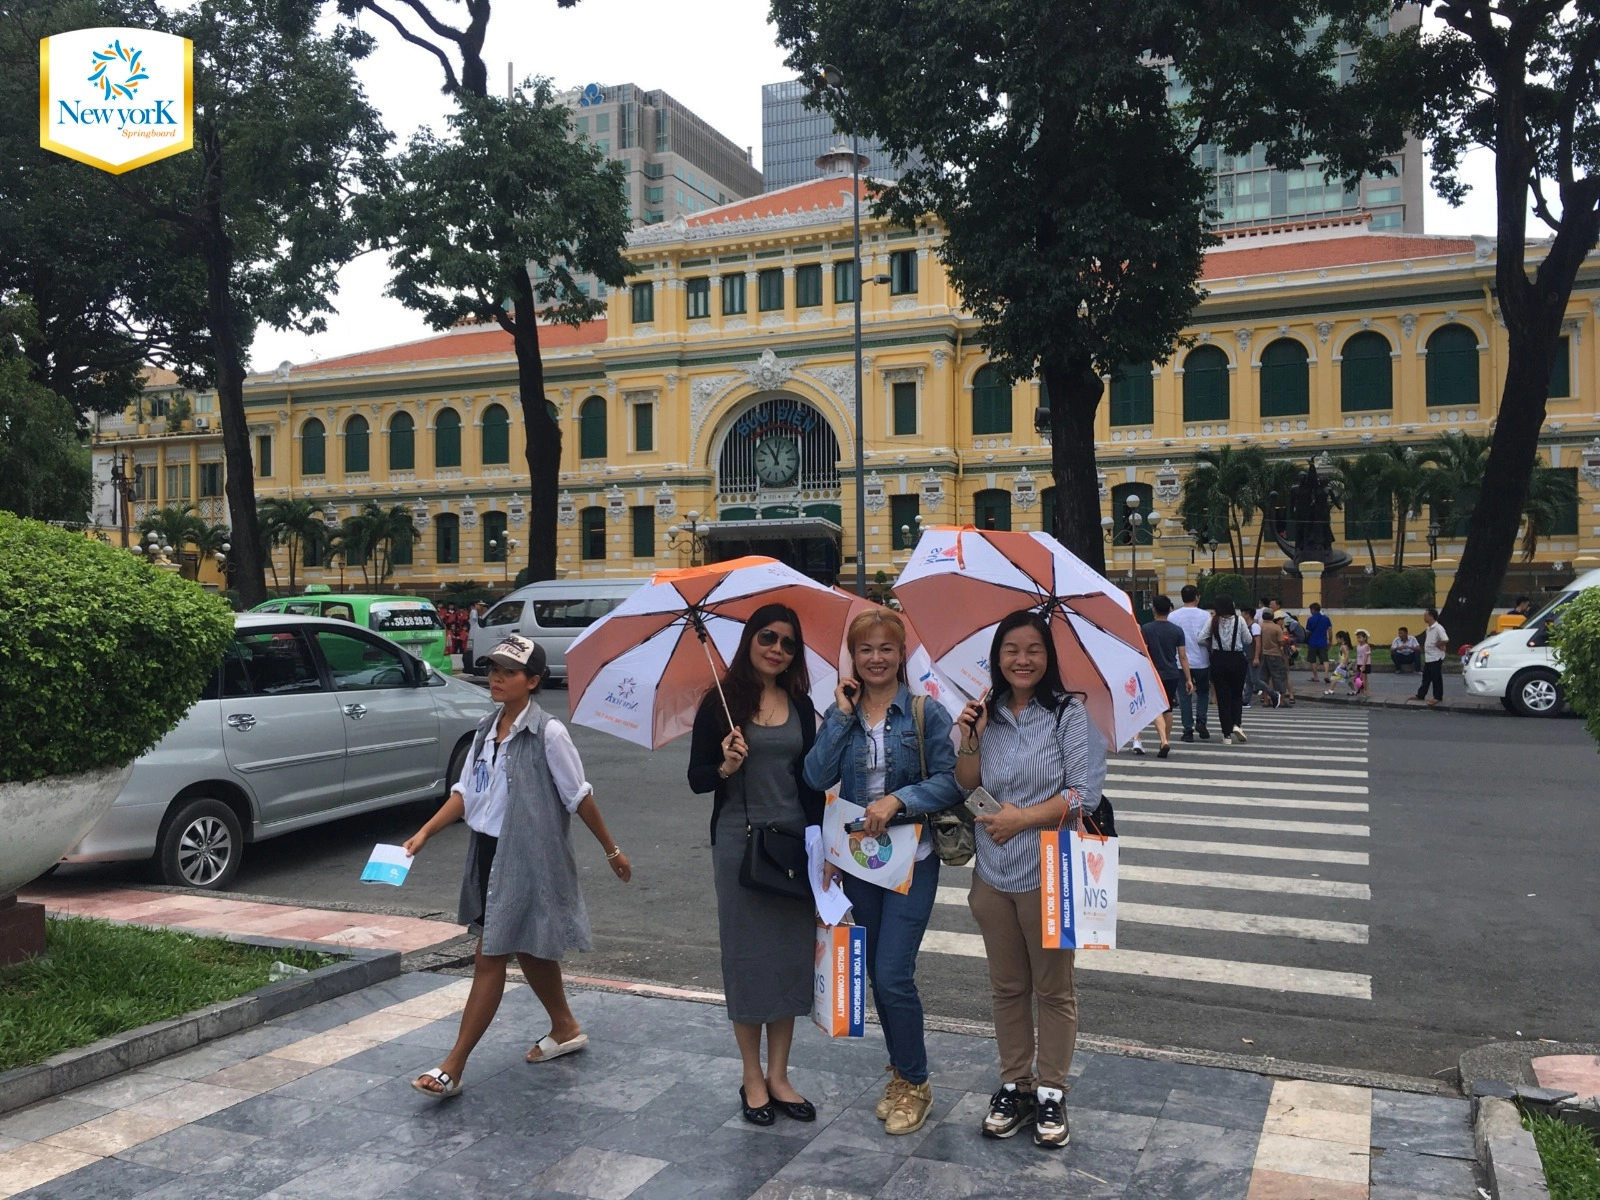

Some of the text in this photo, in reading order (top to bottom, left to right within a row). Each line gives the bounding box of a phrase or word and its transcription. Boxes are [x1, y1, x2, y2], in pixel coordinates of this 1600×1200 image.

[1046, 844, 1056, 936] NEW YORK SPRINGBOARD
[1062, 852, 1070, 897] COMMUNITY
[1084, 888, 1108, 909] NYS
[854, 939, 862, 1025] NEW YORK SPRINGBOARD
